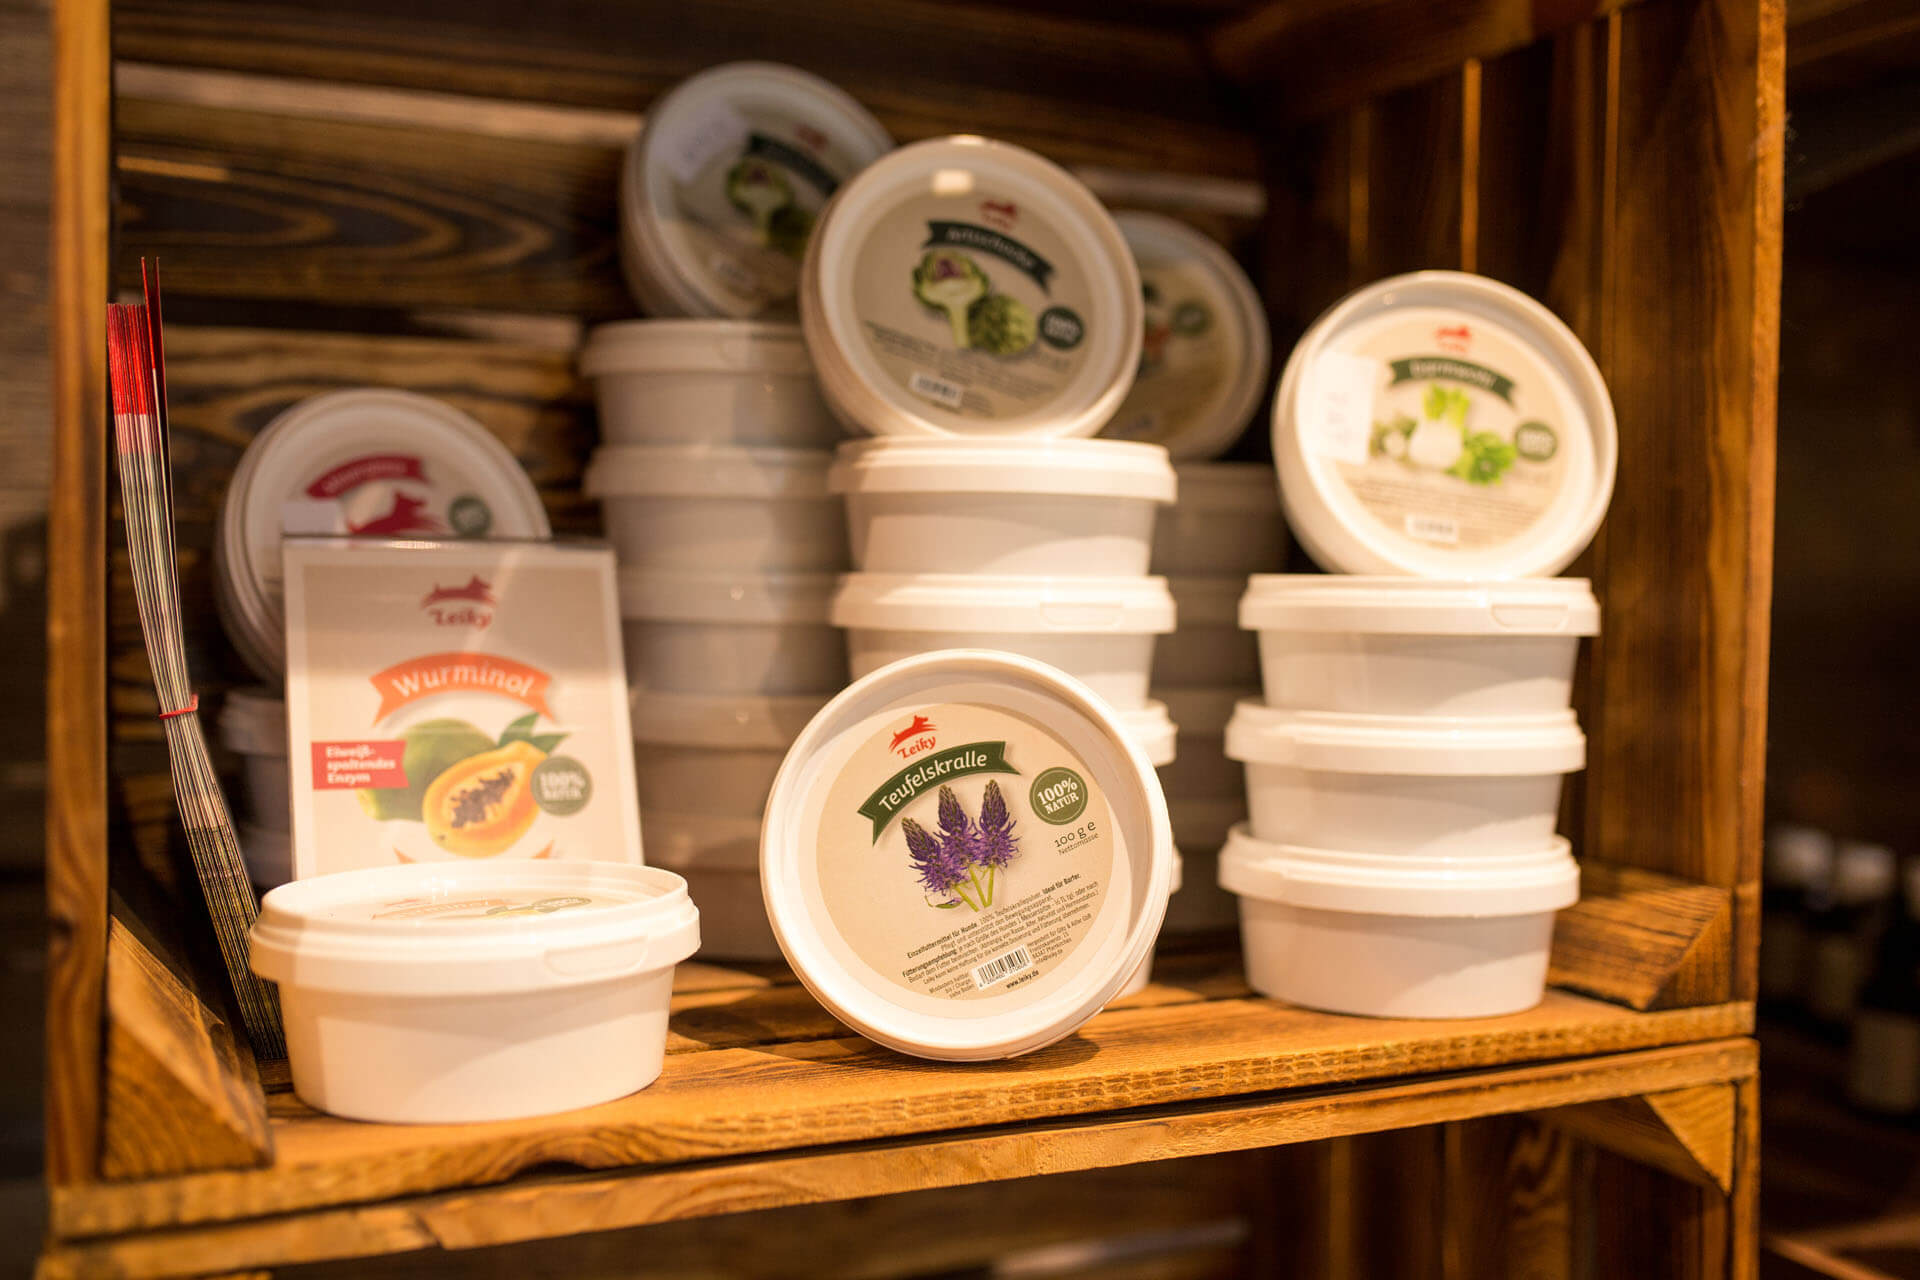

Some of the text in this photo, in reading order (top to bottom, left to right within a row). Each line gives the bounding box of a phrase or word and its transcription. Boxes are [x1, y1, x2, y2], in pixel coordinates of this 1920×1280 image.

[430, 608, 492, 631] Leiky
[391, 660, 534, 698] Wurminol
[326, 746, 375, 758] Eiweiß-
[897, 736, 936, 759] Leiky
[327, 758, 396, 771] spaltendes
[328, 772, 370, 784] Enzym
[539, 770, 586, 788] 100%
[879, 750, 987, 811] Teufelskralle
[1037, 778, 1078, 806] 100%
[1044, 792, 1079, 814] NATUR
[1054, 832, 1074, 848] 100
[1077, 826, 1087, 840] g
